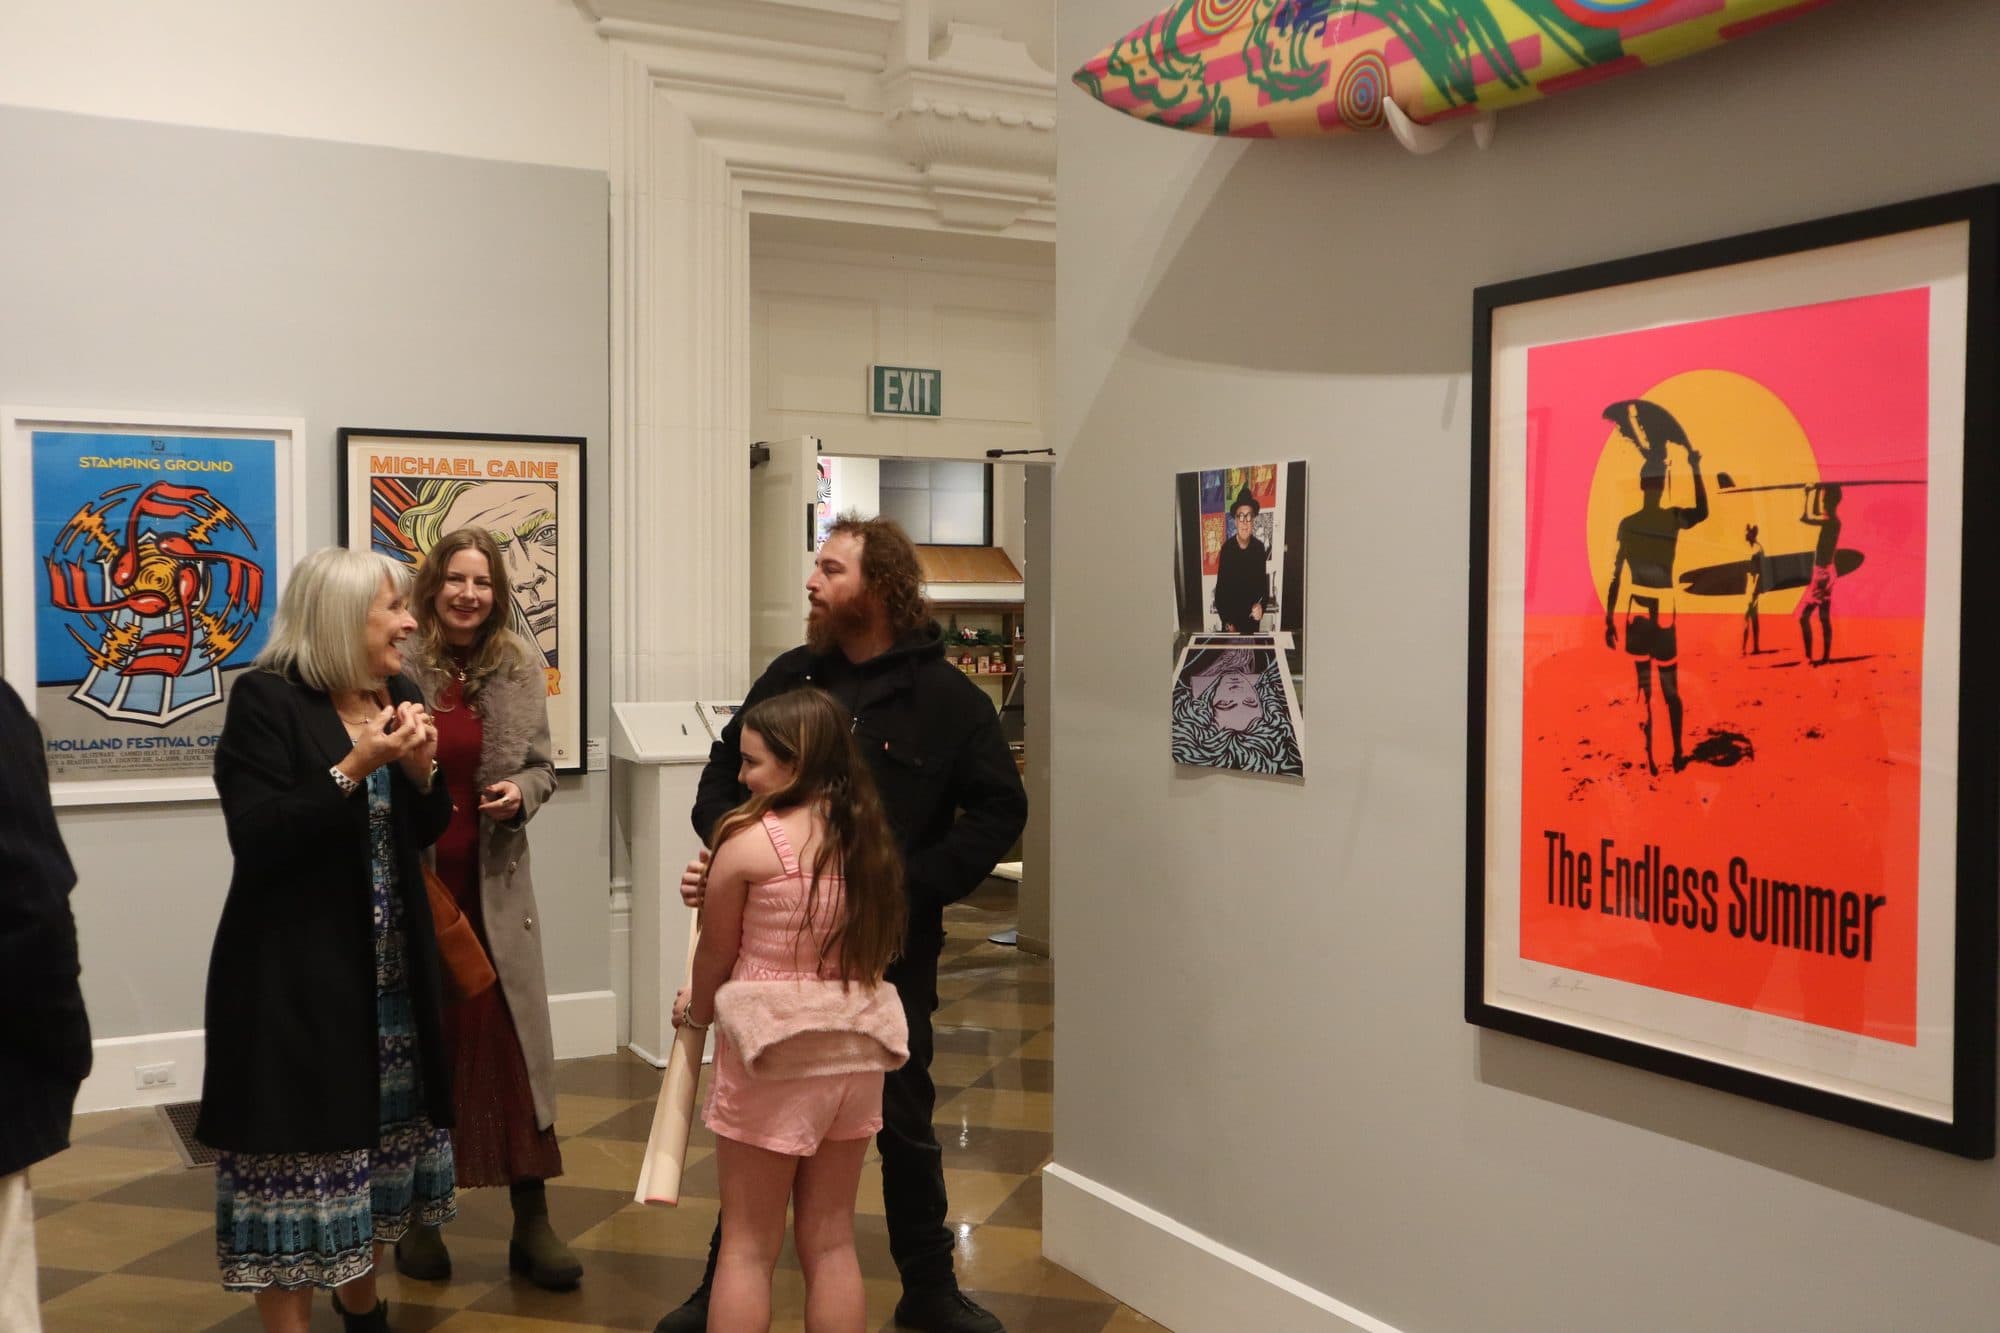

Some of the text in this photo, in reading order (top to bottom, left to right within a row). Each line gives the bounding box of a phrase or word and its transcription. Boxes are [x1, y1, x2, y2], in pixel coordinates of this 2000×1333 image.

[884, 369, 934, 413] EXIT
[79, 456, 233, 473] STAMPING GROUND
[370, 456, 559, 479] MICHAEL CAINE
[47, 738, 122, 751] HOLLAND
[126, 736, 194, 749] FESTIVAL
[1544, 830, 1886, 962] The Endless Summer
